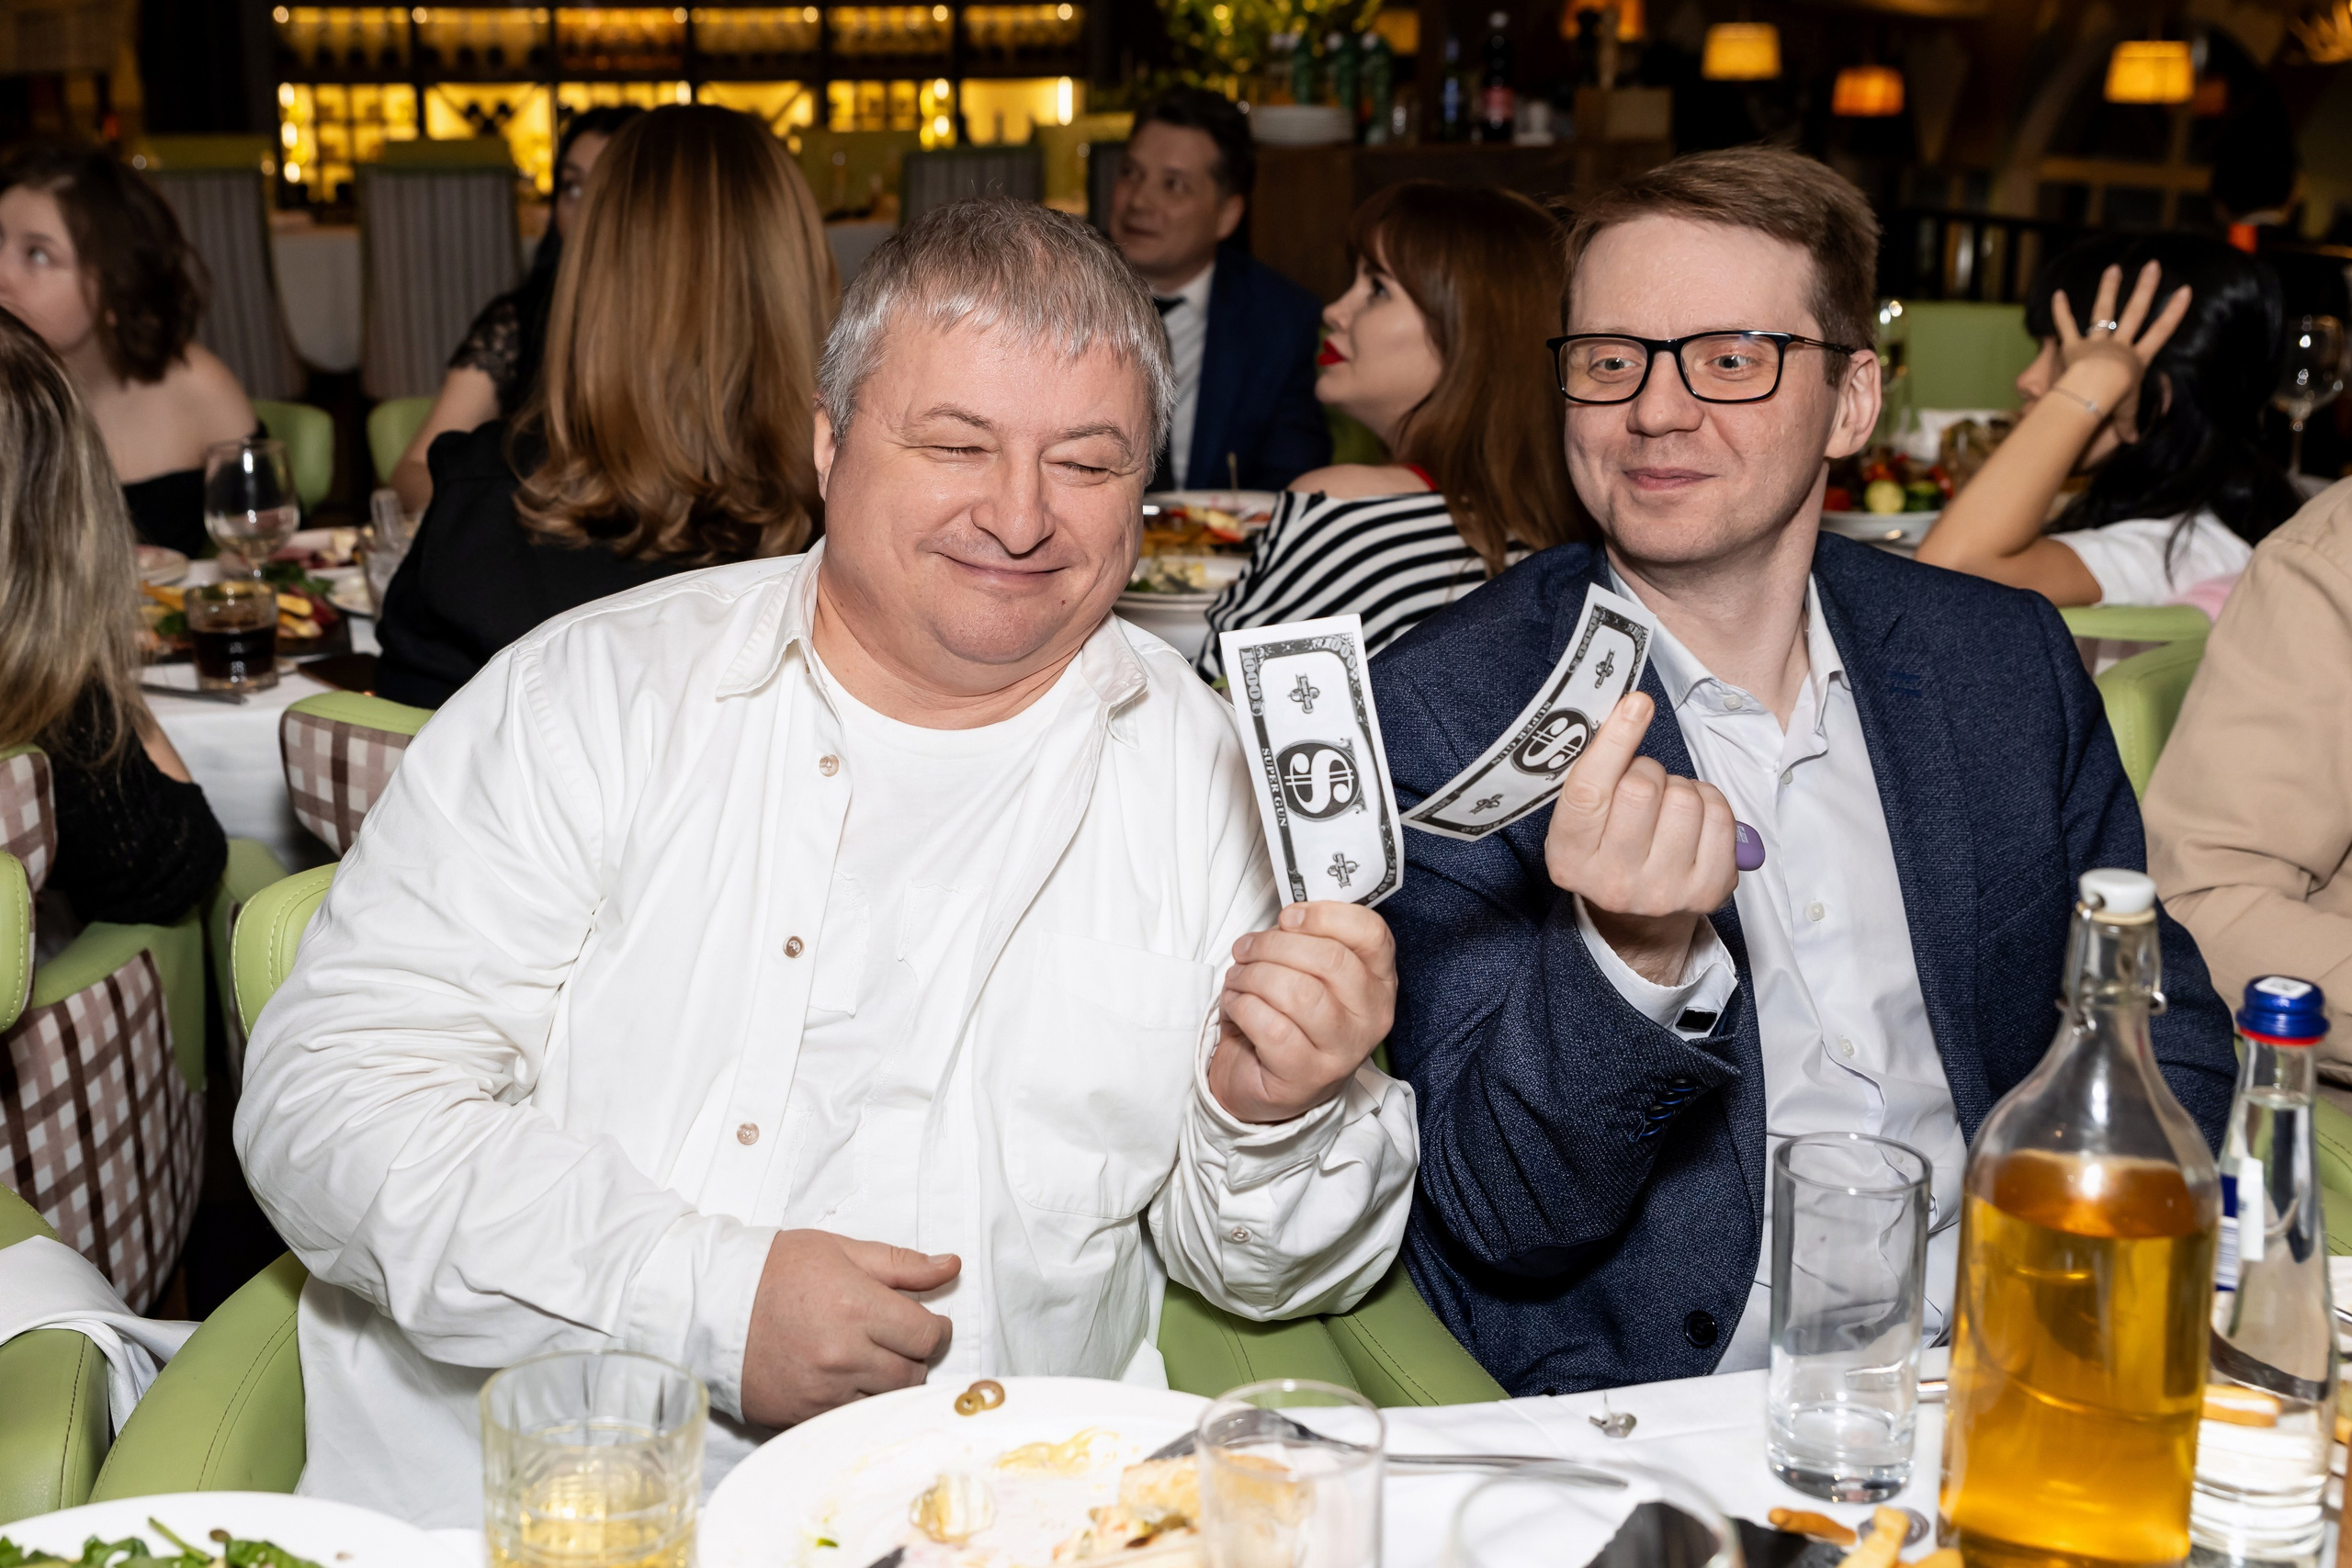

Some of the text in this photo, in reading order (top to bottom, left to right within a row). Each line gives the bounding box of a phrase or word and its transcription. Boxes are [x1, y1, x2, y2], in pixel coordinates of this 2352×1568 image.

[1322, 637, 1357, 670] 1000
[1577, 609, 1600, 658] 1000
[1240, 650, 1262, 701] 1000
[1491, 701, 1552, 765] SUPER GUN
[1521, 716, 1589, 770] $
[1261, 748, 1287, 827] SUPER GUN
[1284, 749, 1355, 815] $
[1291, 882, 1306, 902] 10
